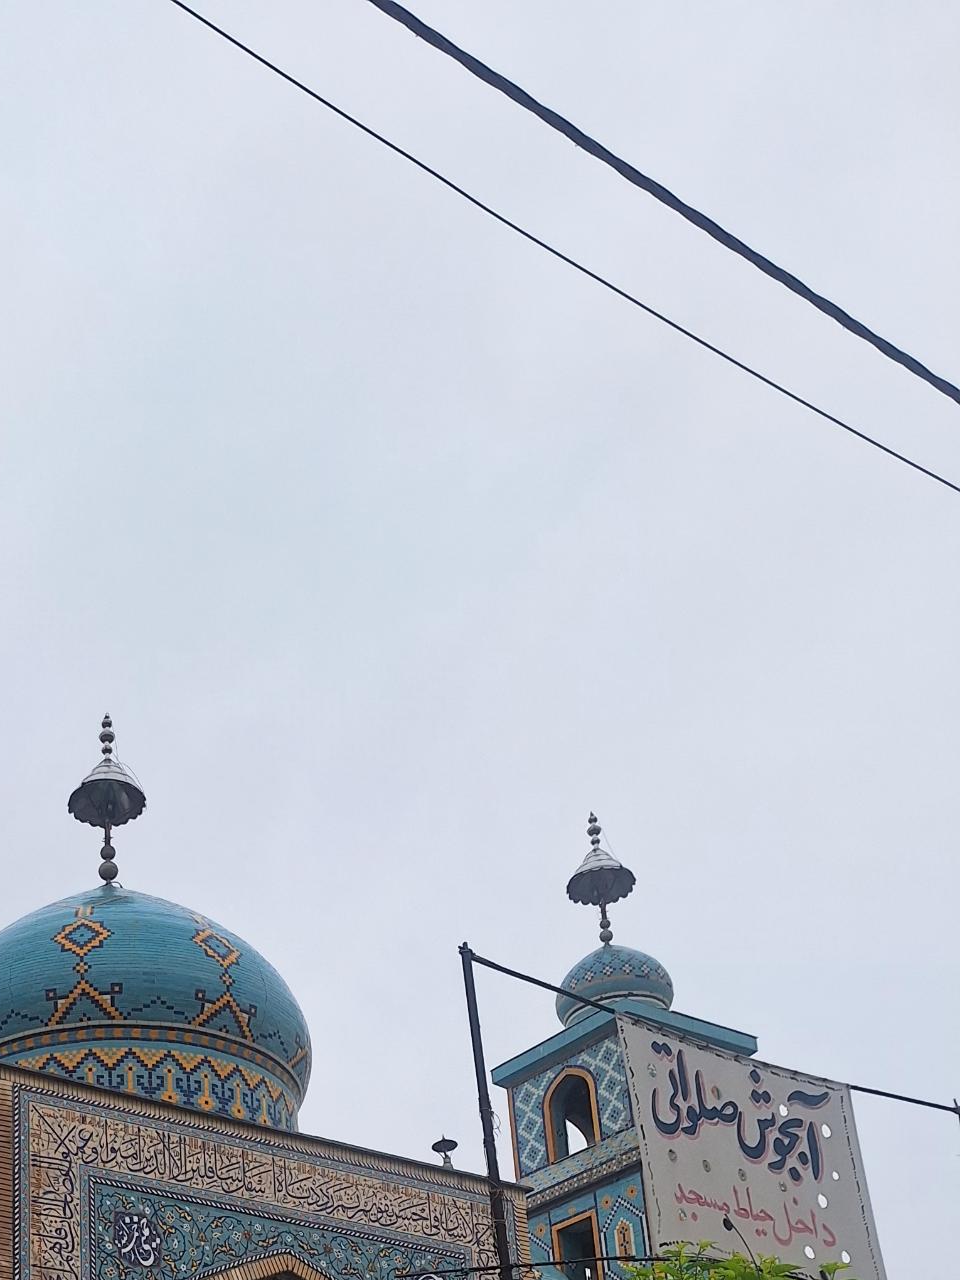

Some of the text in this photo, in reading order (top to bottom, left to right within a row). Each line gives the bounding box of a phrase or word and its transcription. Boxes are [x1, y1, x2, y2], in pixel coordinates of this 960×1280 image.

[651, 1040, 831, 1183] آبجوش صلواتی
[674, 1184, 836, 1247] داخل حیاط مسجد
